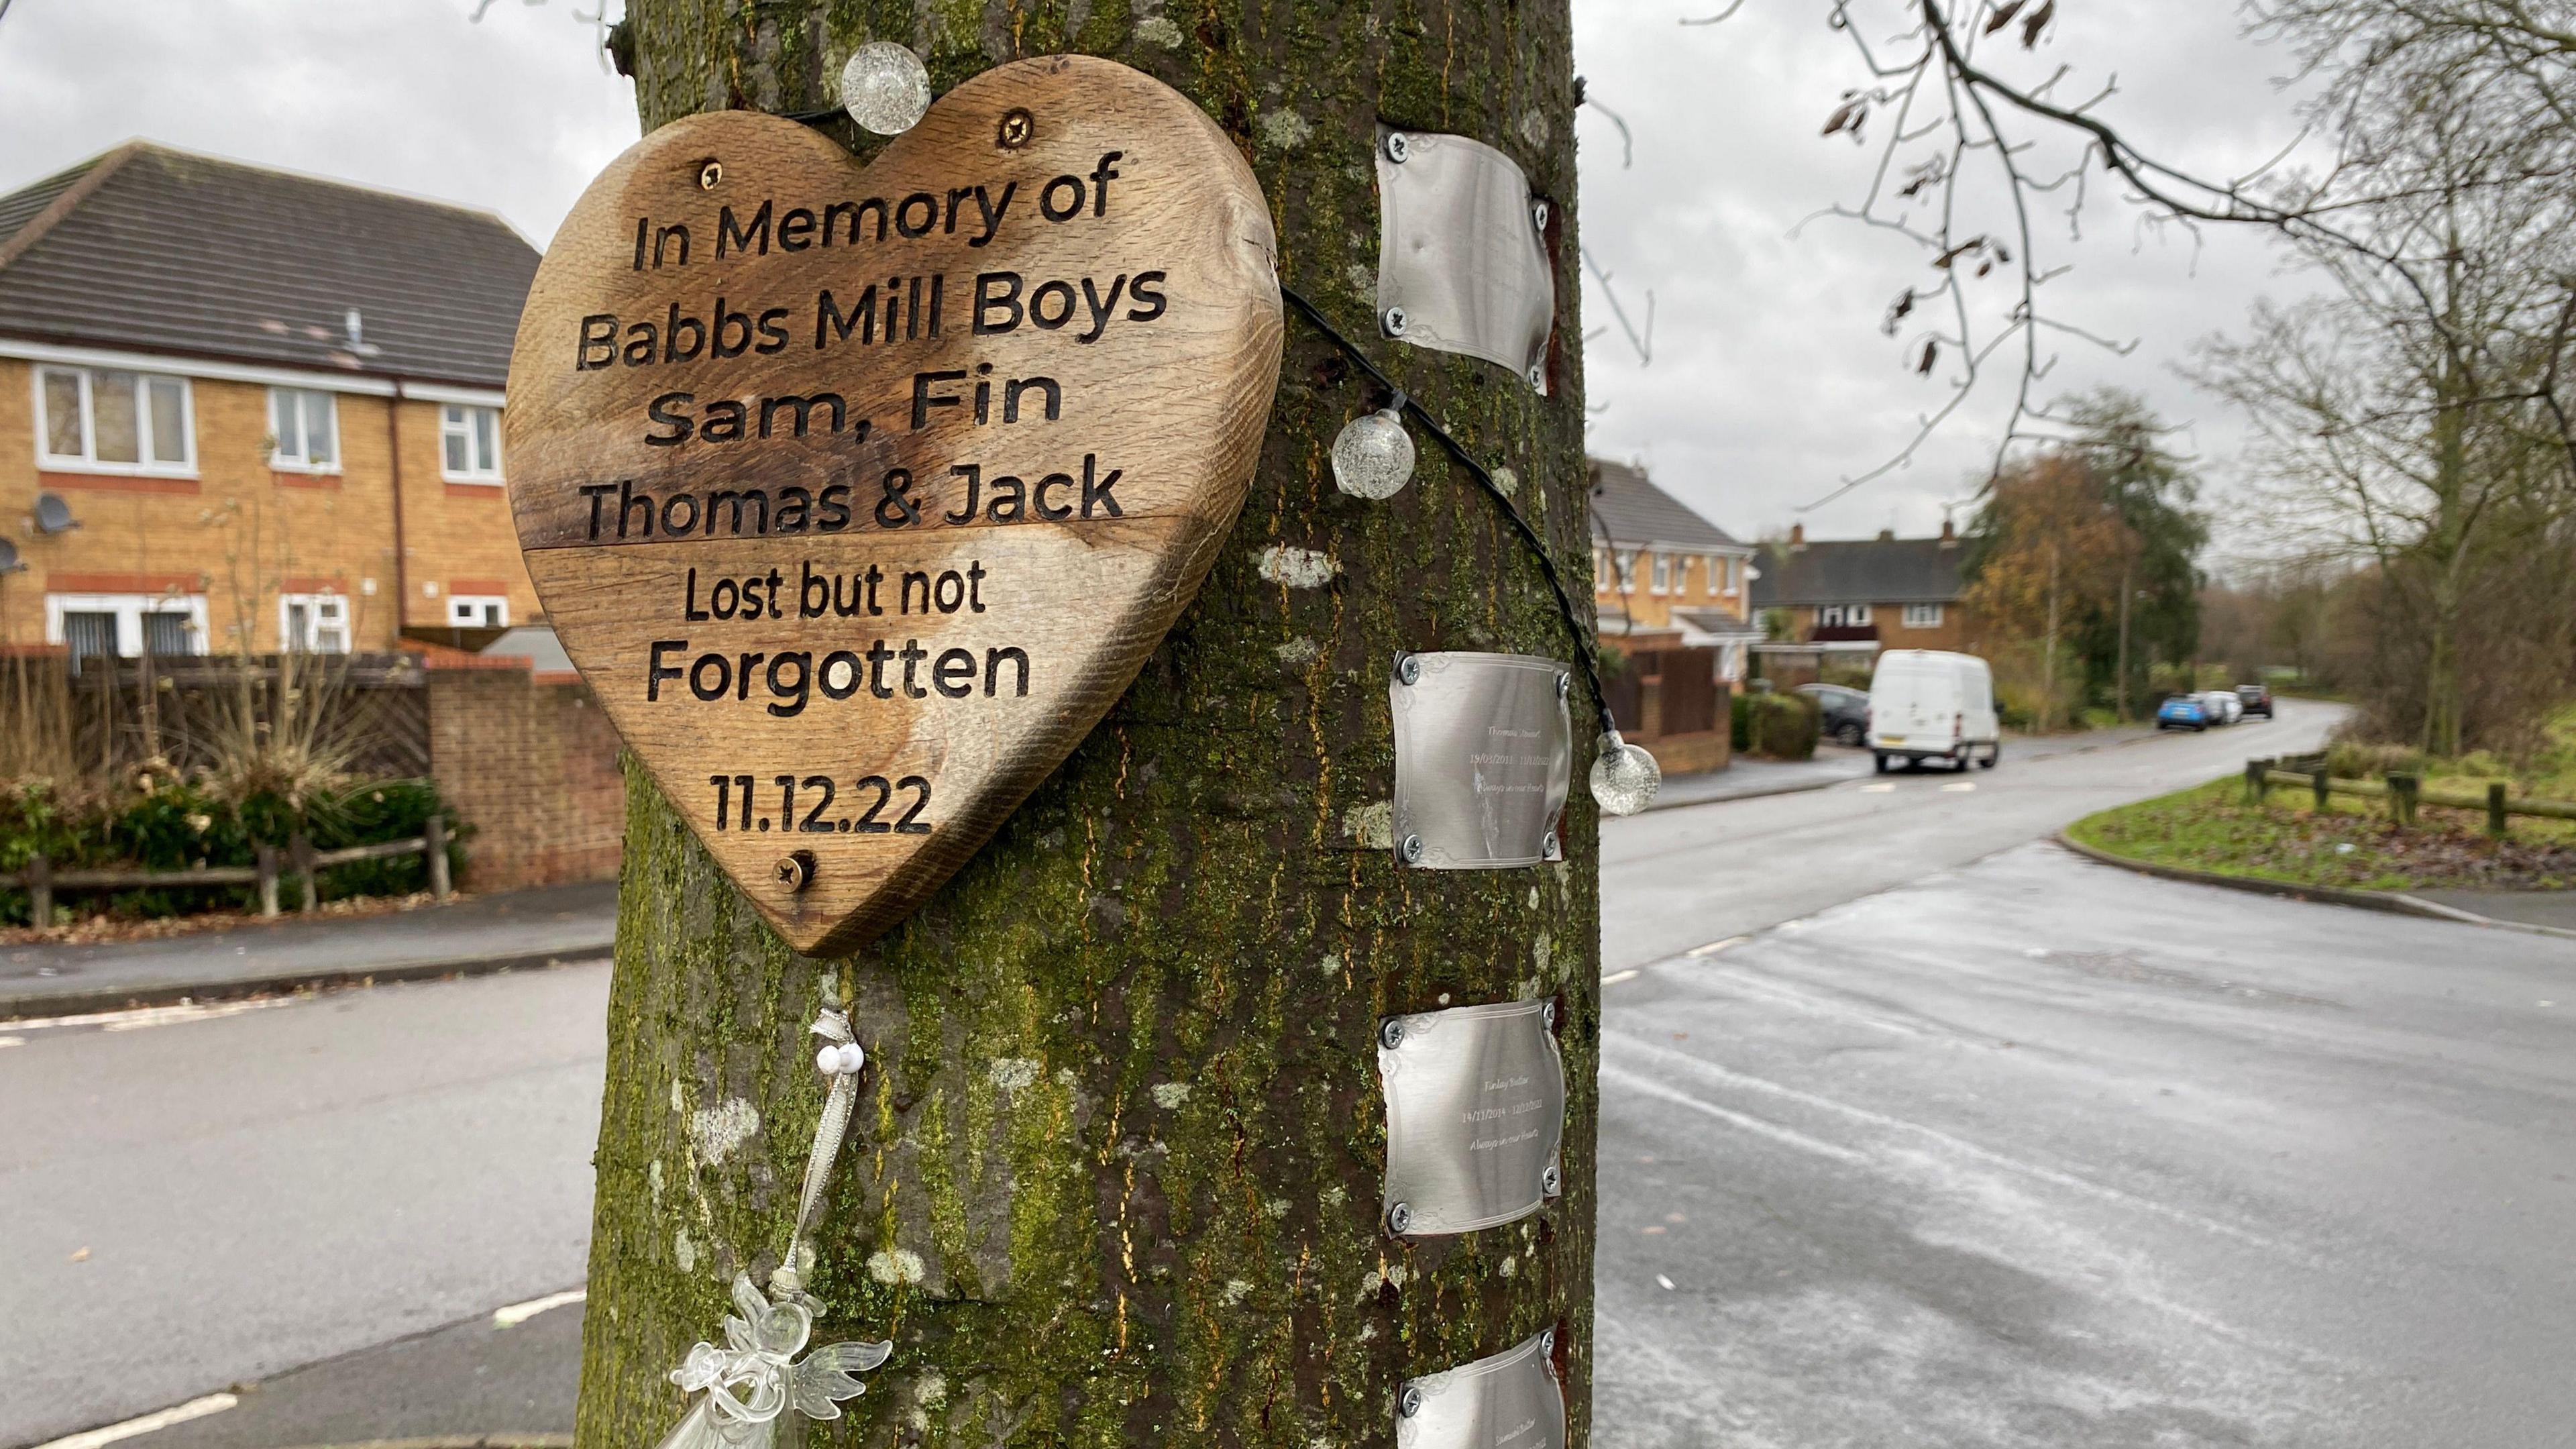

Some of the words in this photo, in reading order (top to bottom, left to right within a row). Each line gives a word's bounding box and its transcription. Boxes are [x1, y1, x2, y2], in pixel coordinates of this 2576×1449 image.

[633, 217, 690, 270] In
[716, 181, 1018, 261] Memory
[1039, 151, 1122, 221] of
[577, 297, 789, 372] Babbs
[815, 274, 943, 350] Mill
[972, 270, 1168, 344] Boys
[644, 392, 872, 446] Sam,
[910, 362, 1061, 429] Fin
[580, 480, 851, 540] Thomas
[875, 468, 922, 527] &
[944, 453, 1123, 525] Jack
[686, 568, 783, 621] Lost
[800, 560, 883, 619] but
[901, 560, 986, 615] not
[647, 639, 1030, 717] Forgotten
[710, 775, 931, 834] 11.12.22
